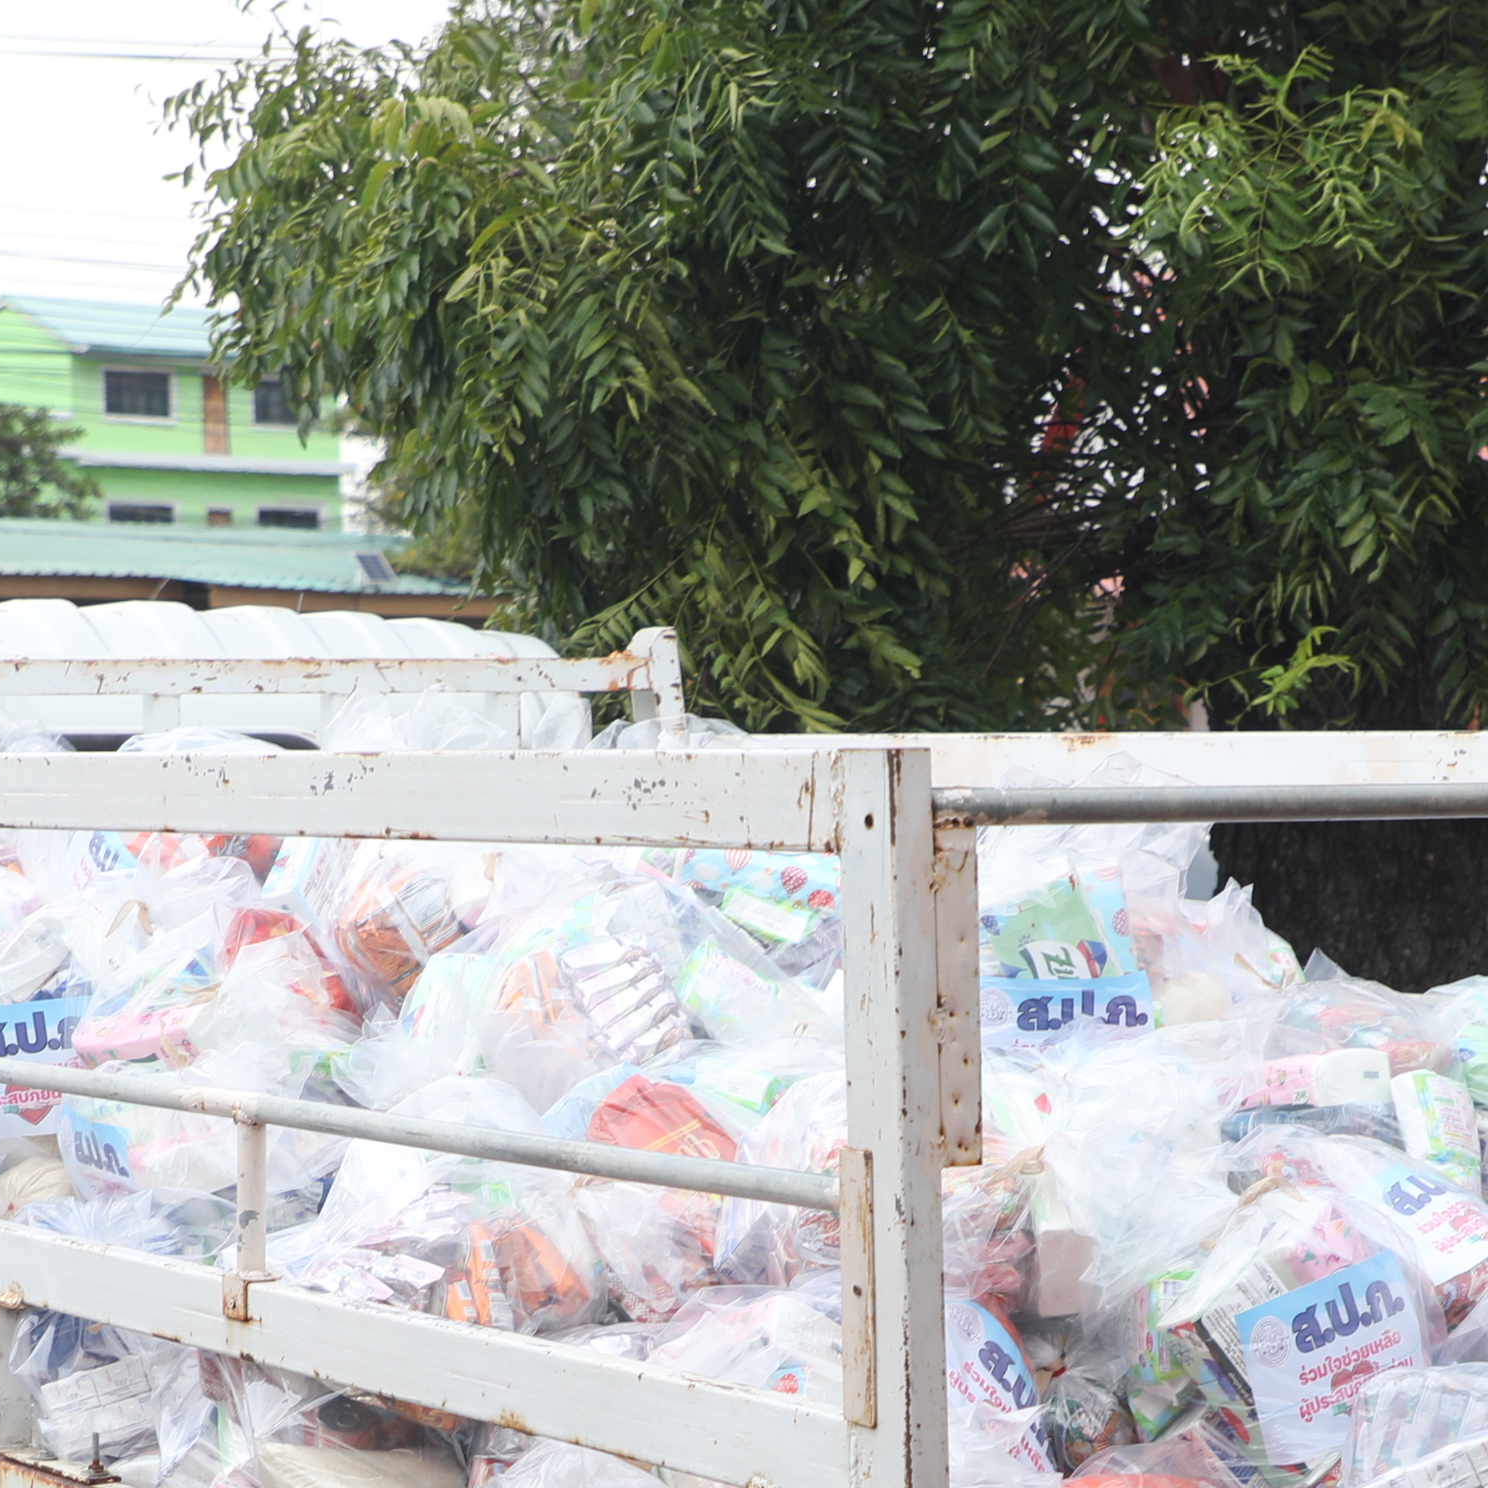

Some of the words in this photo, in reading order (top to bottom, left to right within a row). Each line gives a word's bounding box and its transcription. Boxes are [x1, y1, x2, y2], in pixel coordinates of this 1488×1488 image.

[1291, 1279, 1406, 1354] ส.ป.ก.
[1298, 1329, 1403, 1387] ร่วมใจช่วยเหลือ
